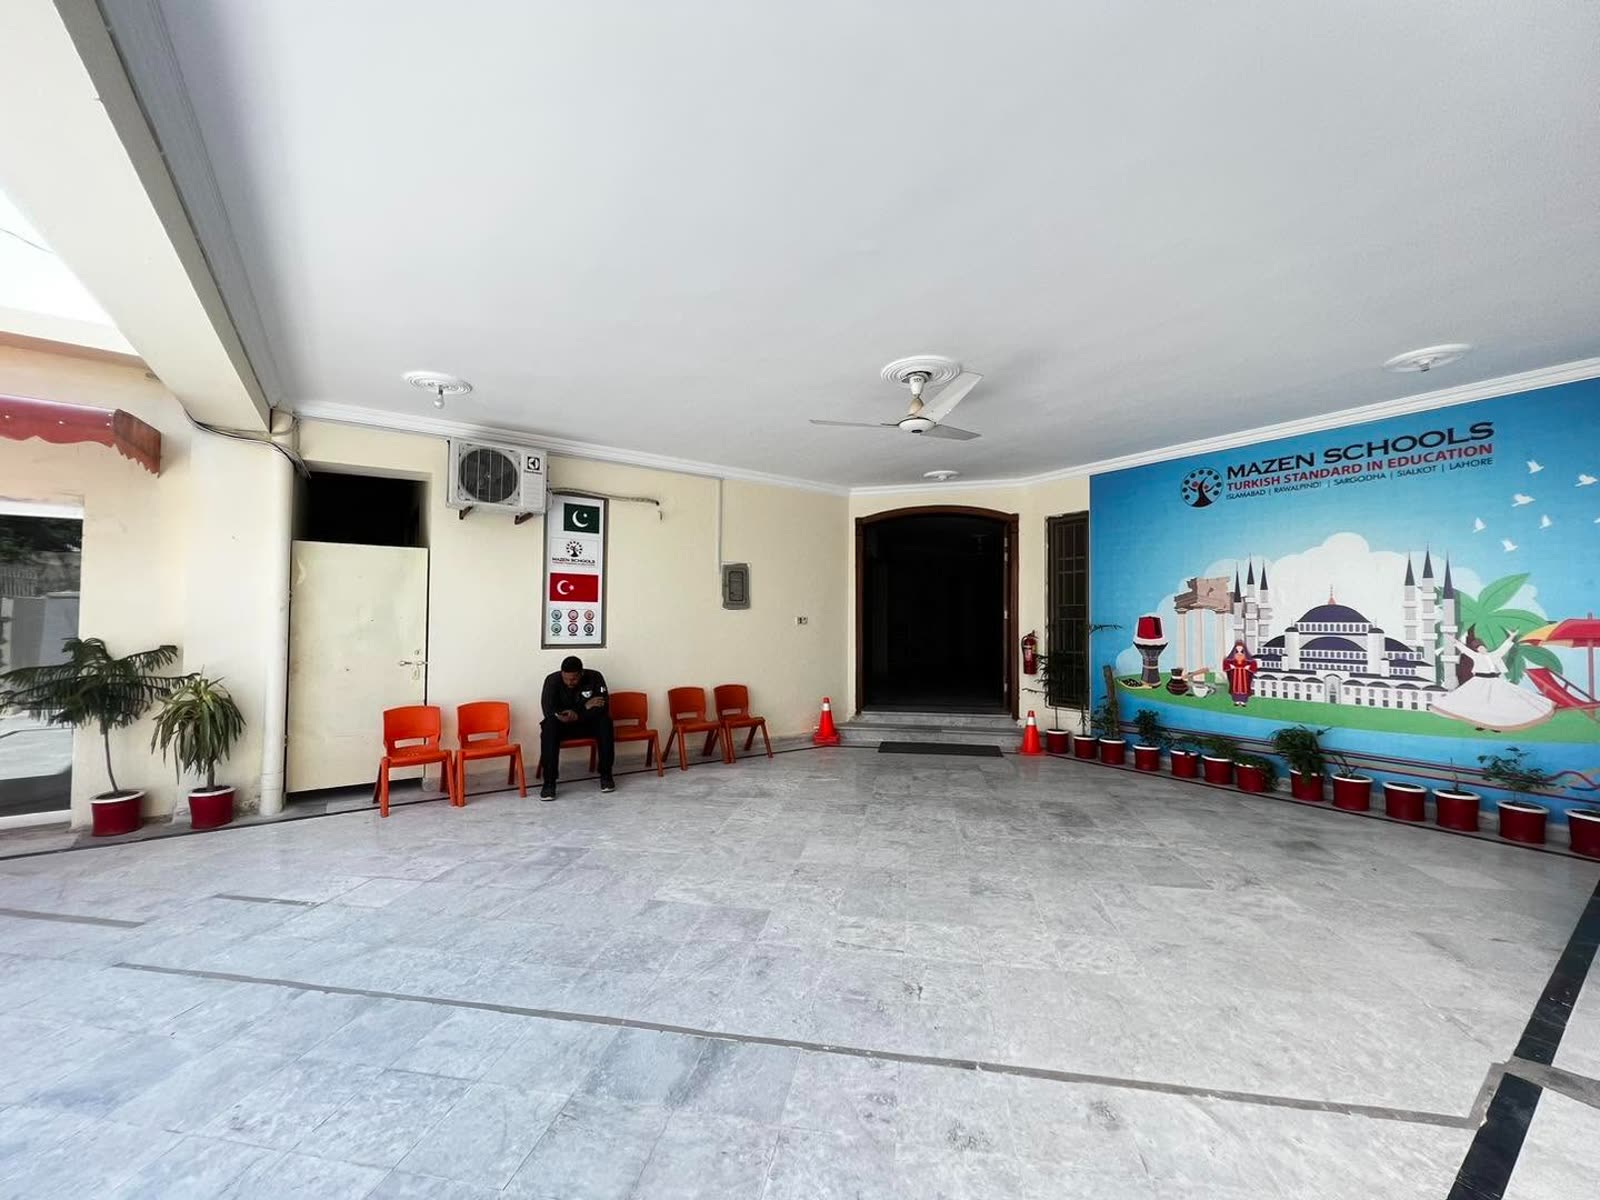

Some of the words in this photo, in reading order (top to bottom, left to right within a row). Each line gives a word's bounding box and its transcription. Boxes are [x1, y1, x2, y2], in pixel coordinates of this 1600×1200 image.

[1226, 476, 1281, 491] TURKISH
[1284, 463, 1363, 484] STANDARD
[1367, 459, 1383, 471] IN
[1388, 443, 1494, 469] EDUCATION
[1227, 452, 1315, 480] MAZEN
[1324, 422, 1495, 465] SCHOOLS
[1226, 489, 1266, 500] ISLAMABAD
[1274, 481, 1322, 494] RAWALPINDI
[1334, 472, 1386, 486] SARGODHA
[1397, 465, 1438, 478] SIALKOT
[1449, 457, 1494, 471] LAHORE
